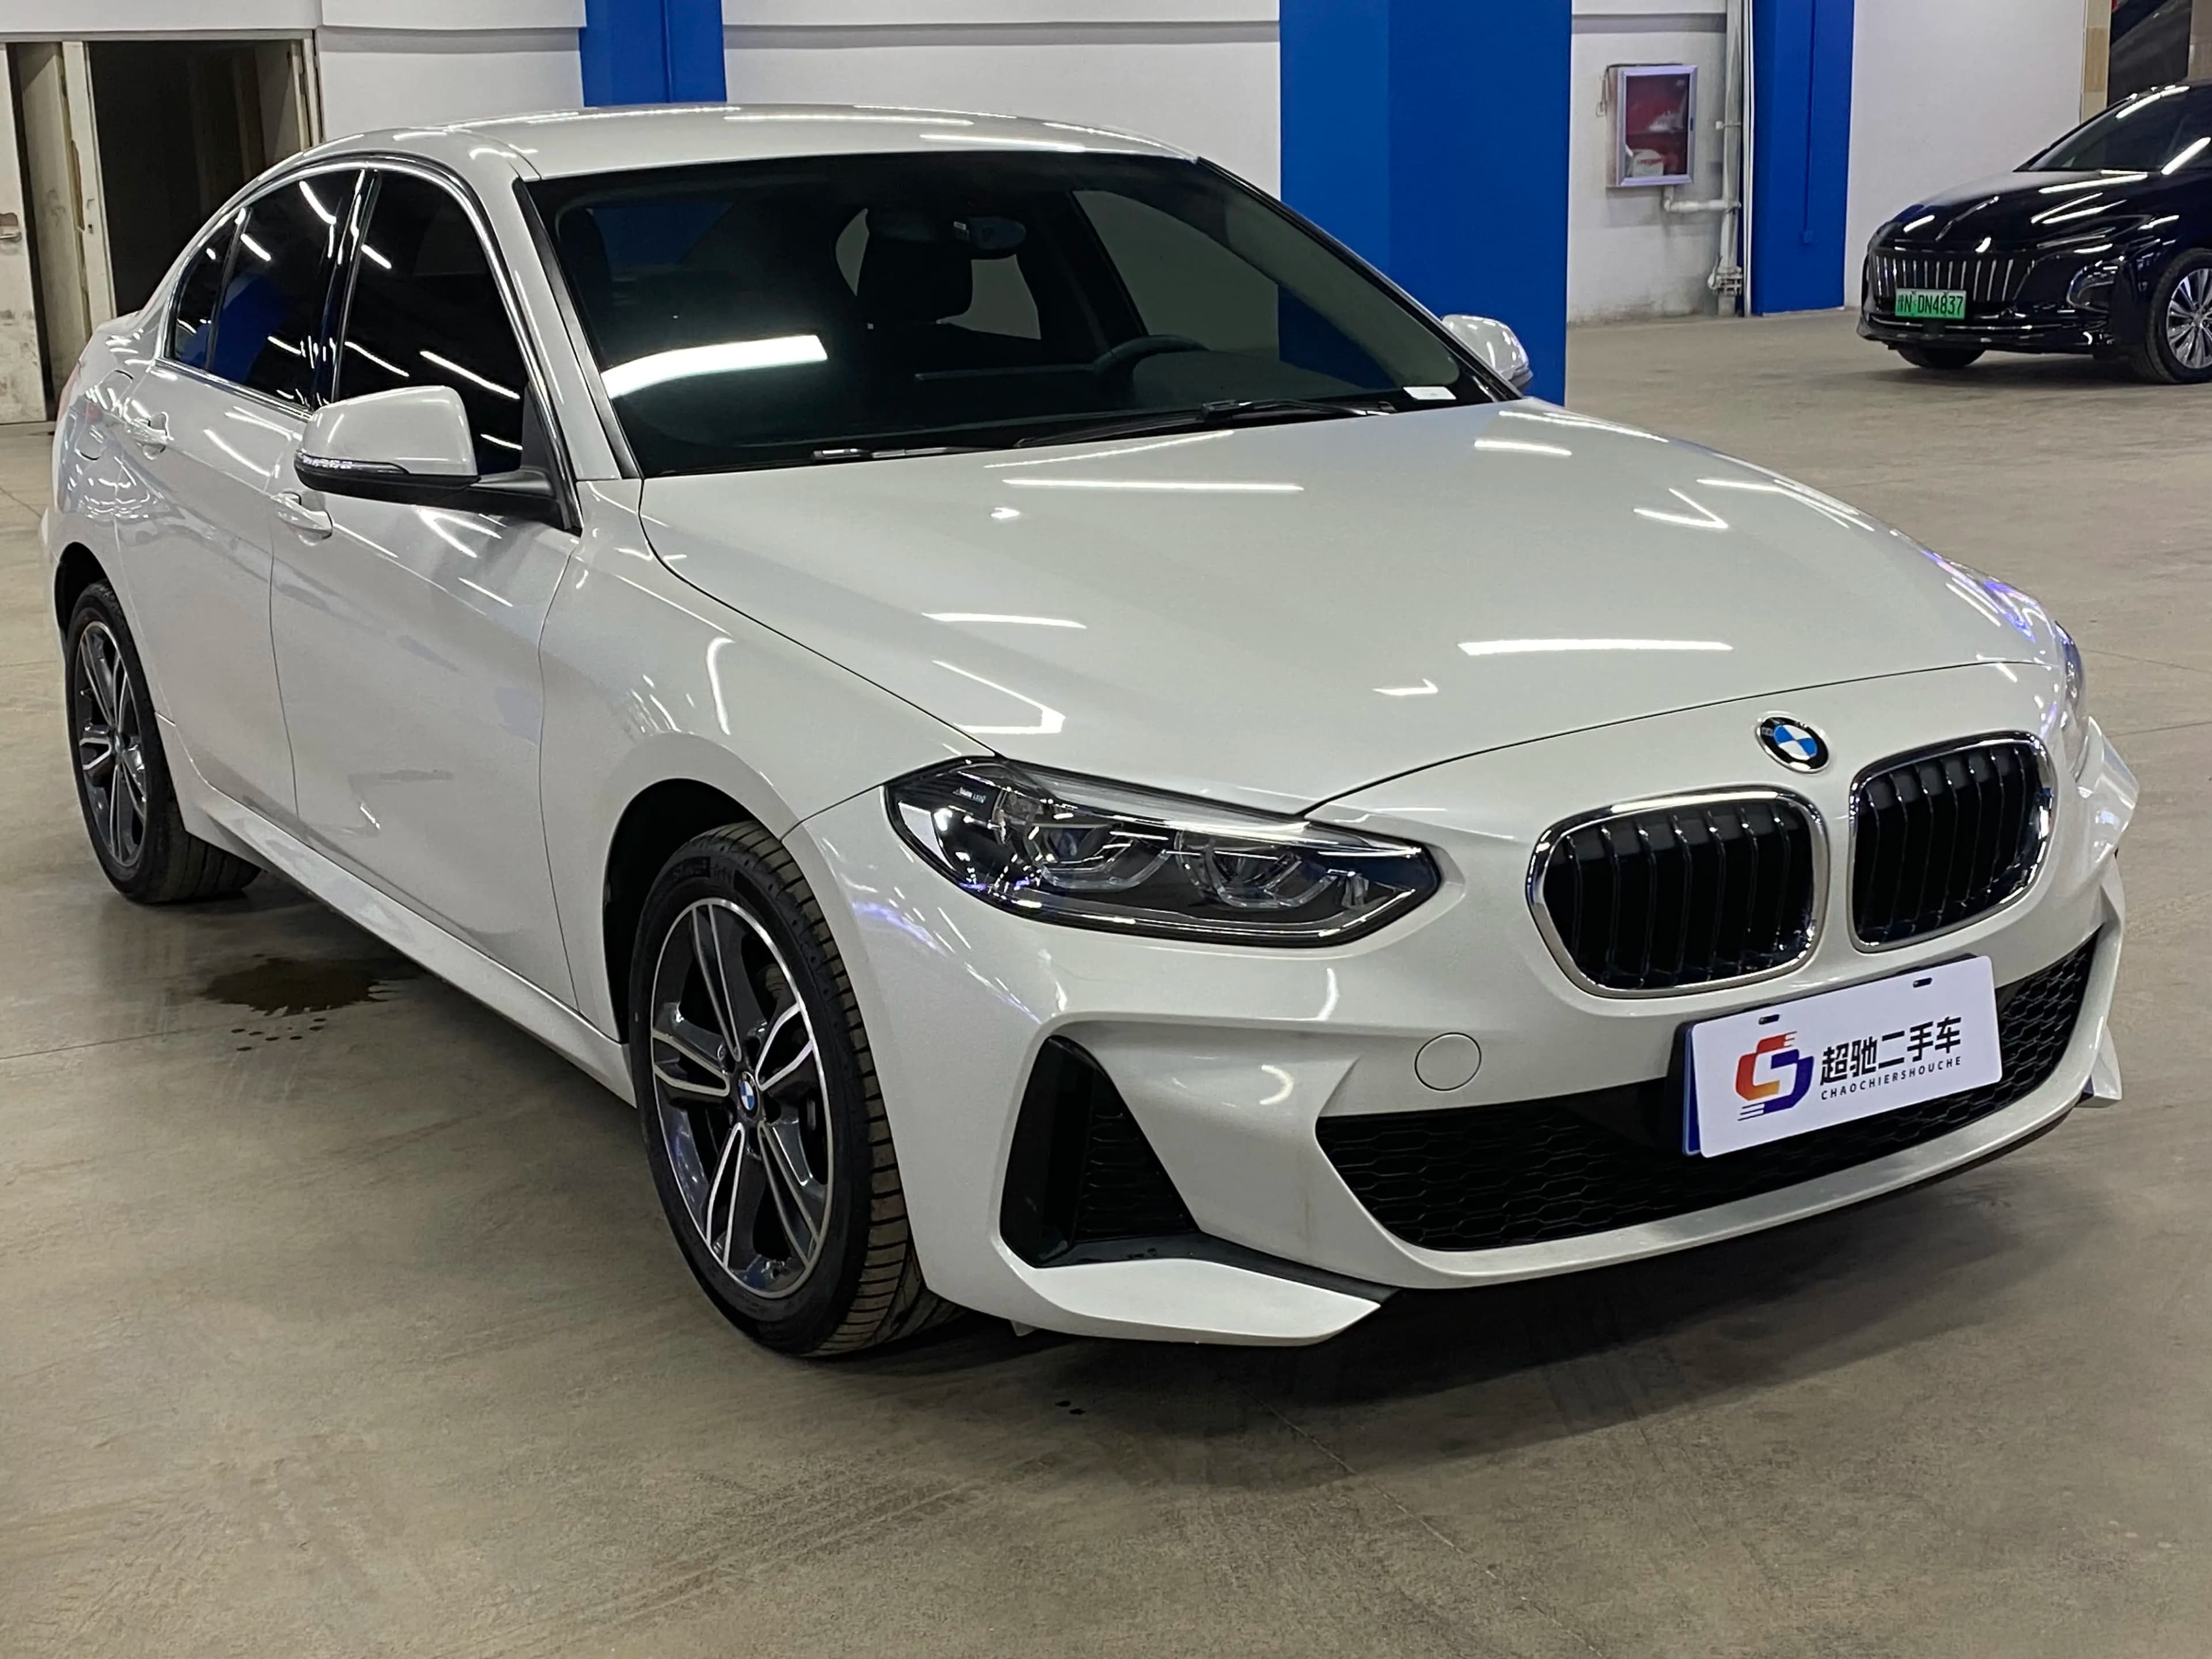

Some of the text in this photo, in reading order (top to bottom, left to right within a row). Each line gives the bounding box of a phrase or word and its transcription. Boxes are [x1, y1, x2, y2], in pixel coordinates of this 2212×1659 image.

[1820, 1016, 1961, 1086] 超驰二手车
[1821, 1056, 1961, 1100] CHAOCHIERSHOUCHE
